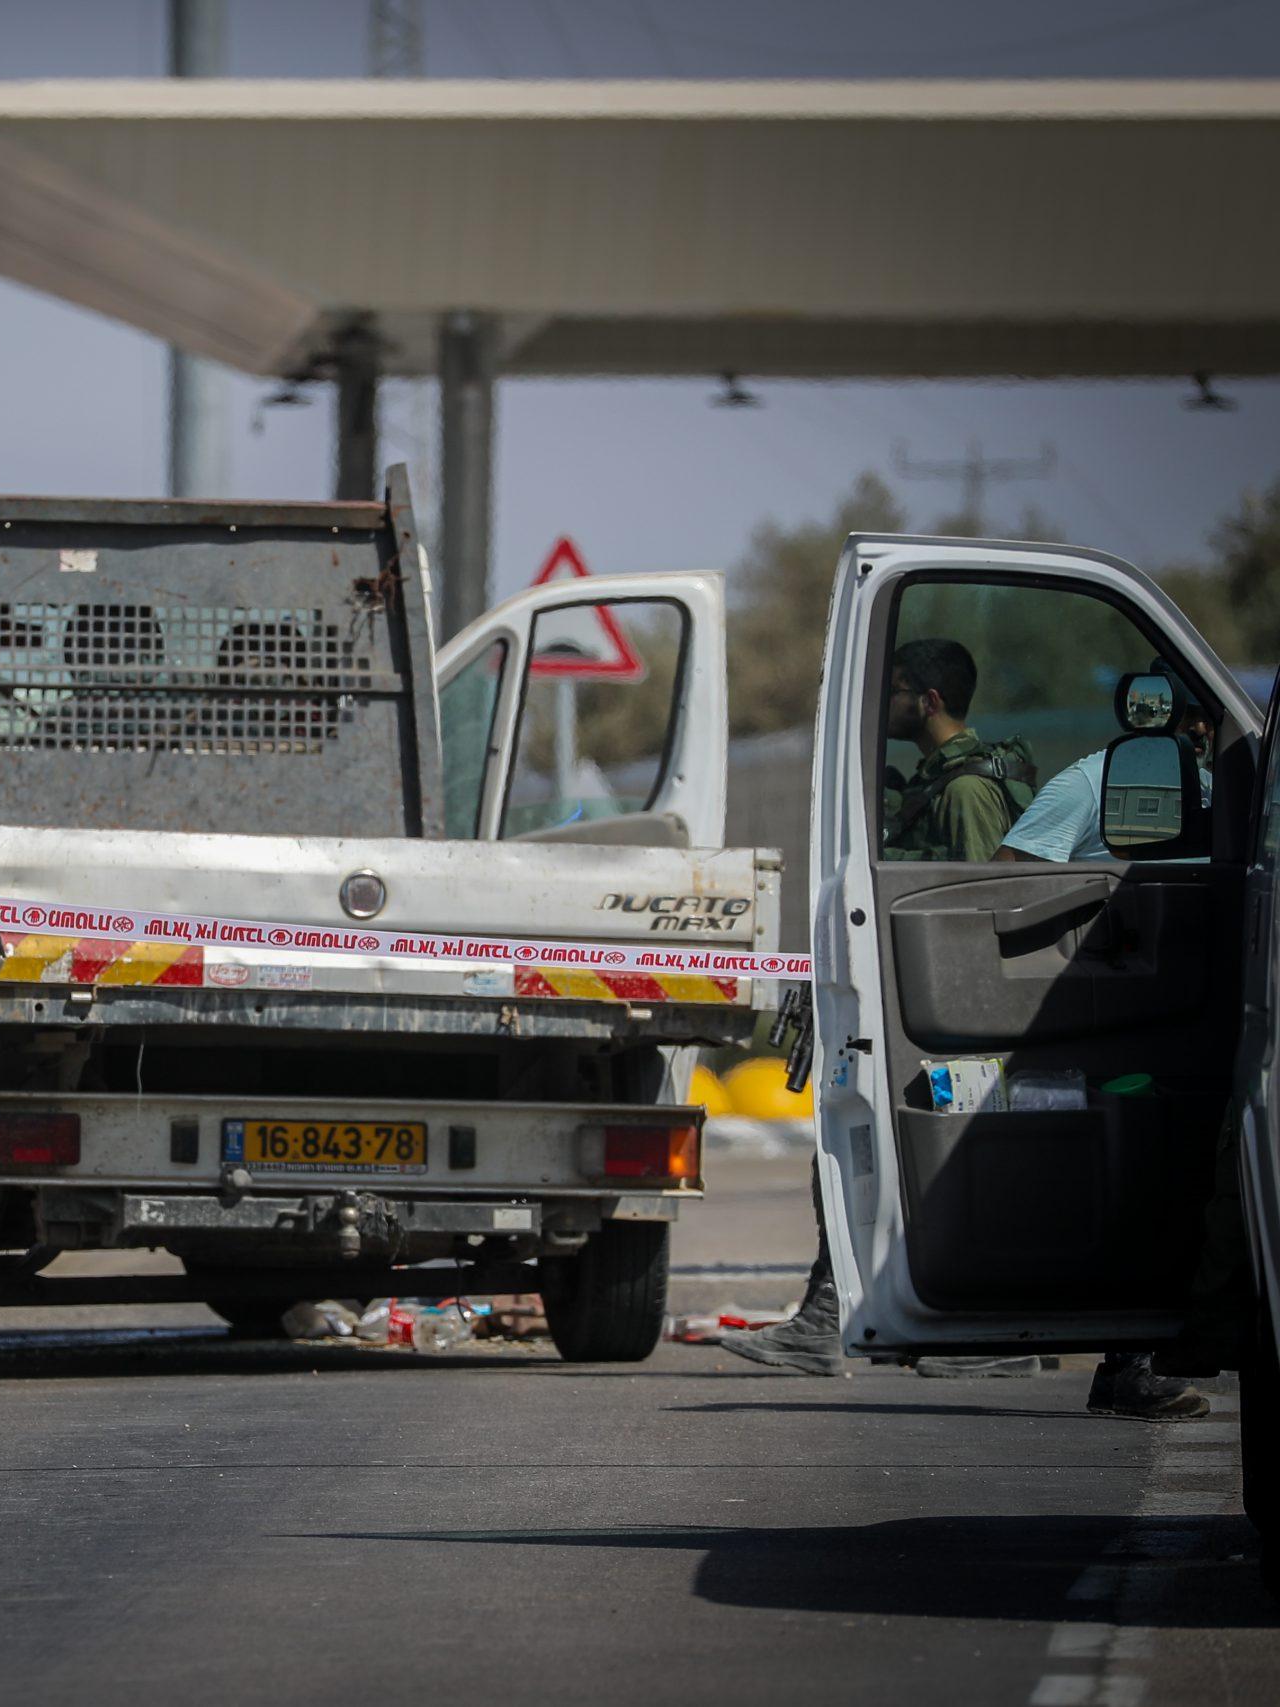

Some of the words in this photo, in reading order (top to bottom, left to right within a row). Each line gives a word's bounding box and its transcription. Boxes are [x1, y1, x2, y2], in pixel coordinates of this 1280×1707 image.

[593, 893, 752, 916] DUCATO
[650, 915, 737, 931] MAXI
[48, 910, 113, 932] משטרת
[144, 919, 191, 941] ישראל
[195, 921, 218, 940] אין
[220, 925, 267, 943] מעבר
[294, 931, 358, 949] משטרת
[390, 938, 438, 957] ישראל
[441, 939, 464, 956] אין
[466, 943, 512, 960] מעבר
[540, 947, 605, 963] משטרת
[636, 953, 685, 971] ישראל
[687, 952, 710, 969] אין
[713, 956, 759, 970] מעבר
